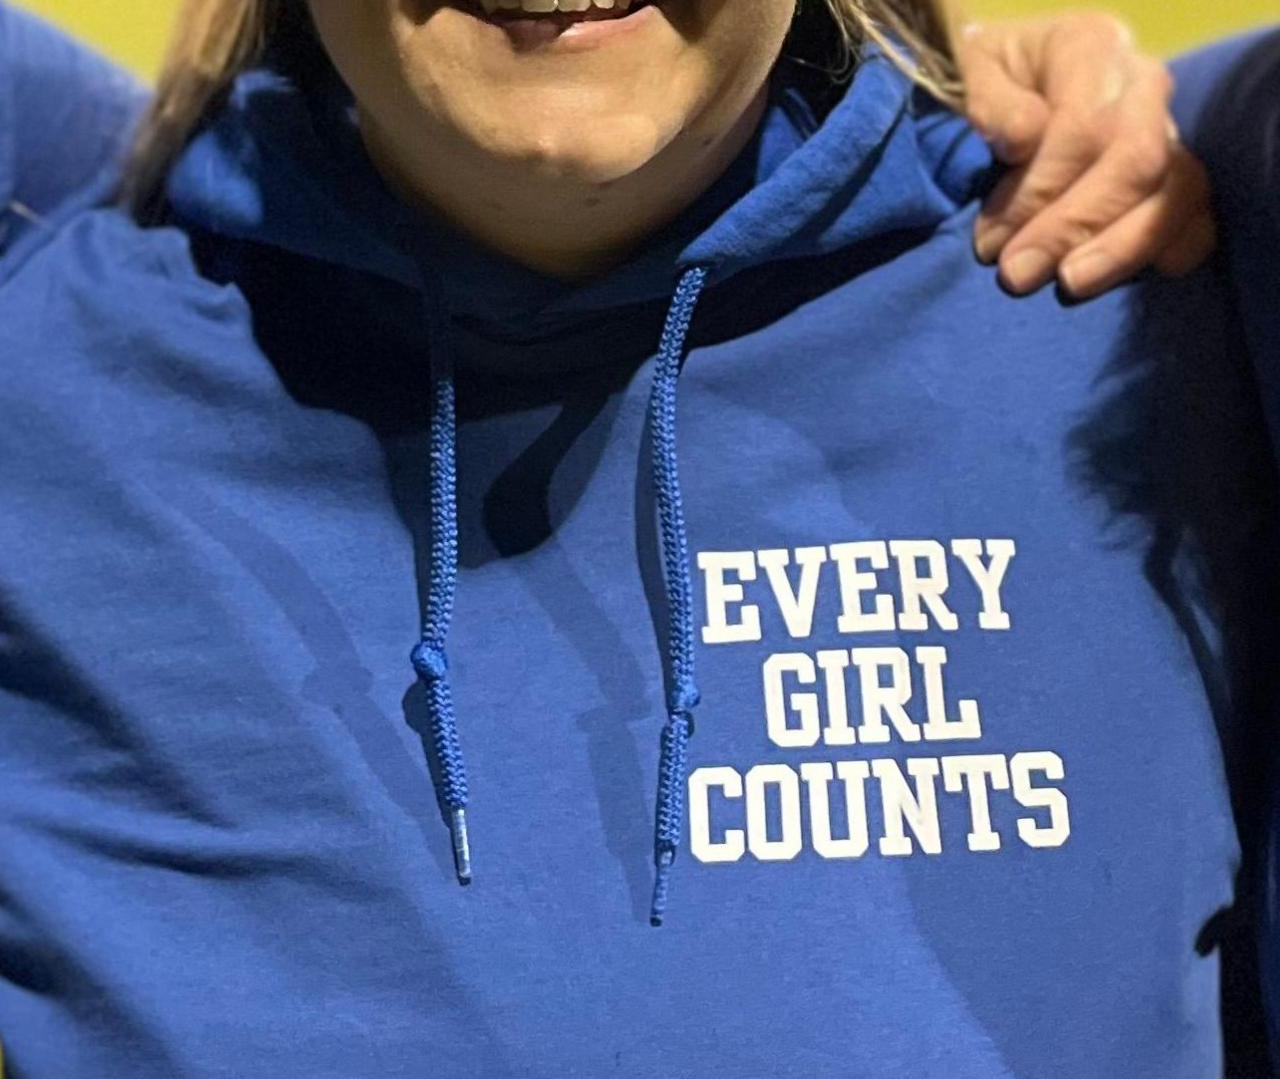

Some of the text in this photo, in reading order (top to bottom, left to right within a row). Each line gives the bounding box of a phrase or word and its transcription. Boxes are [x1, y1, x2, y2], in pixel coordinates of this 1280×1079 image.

[697, 538, 1016, 644] EVERY
[763, 646, 982, 748] GIRL
[688, 751, 1070, 863] COUNTS
